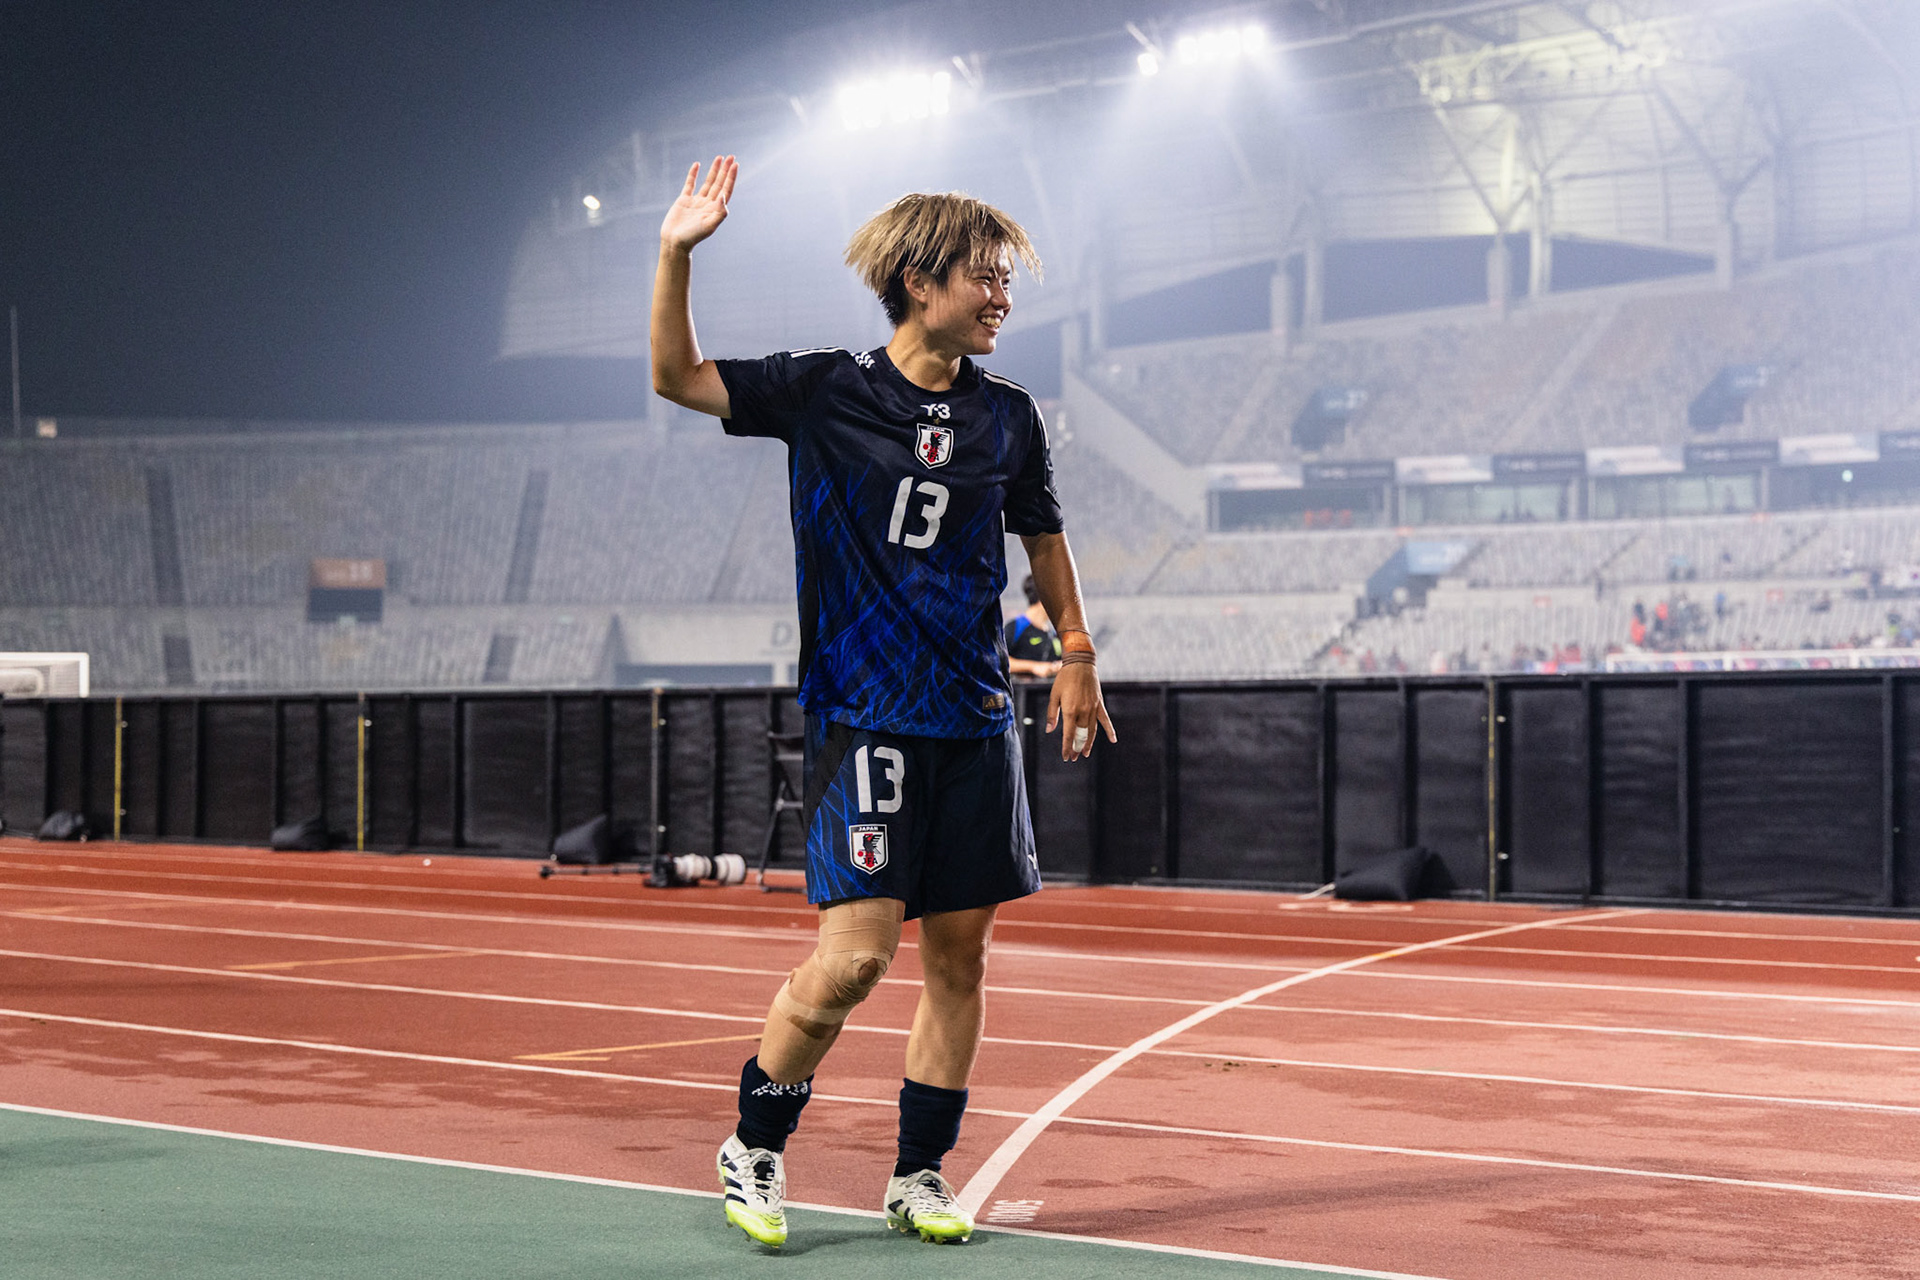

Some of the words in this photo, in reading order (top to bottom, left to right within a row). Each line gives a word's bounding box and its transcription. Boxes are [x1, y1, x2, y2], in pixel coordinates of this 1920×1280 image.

[919, 403, 951, 420] Y-3
[887, 476, 950, 550] 13
[855, 745, 905, 814] 13
[861, 857, 879, 865] JFA
